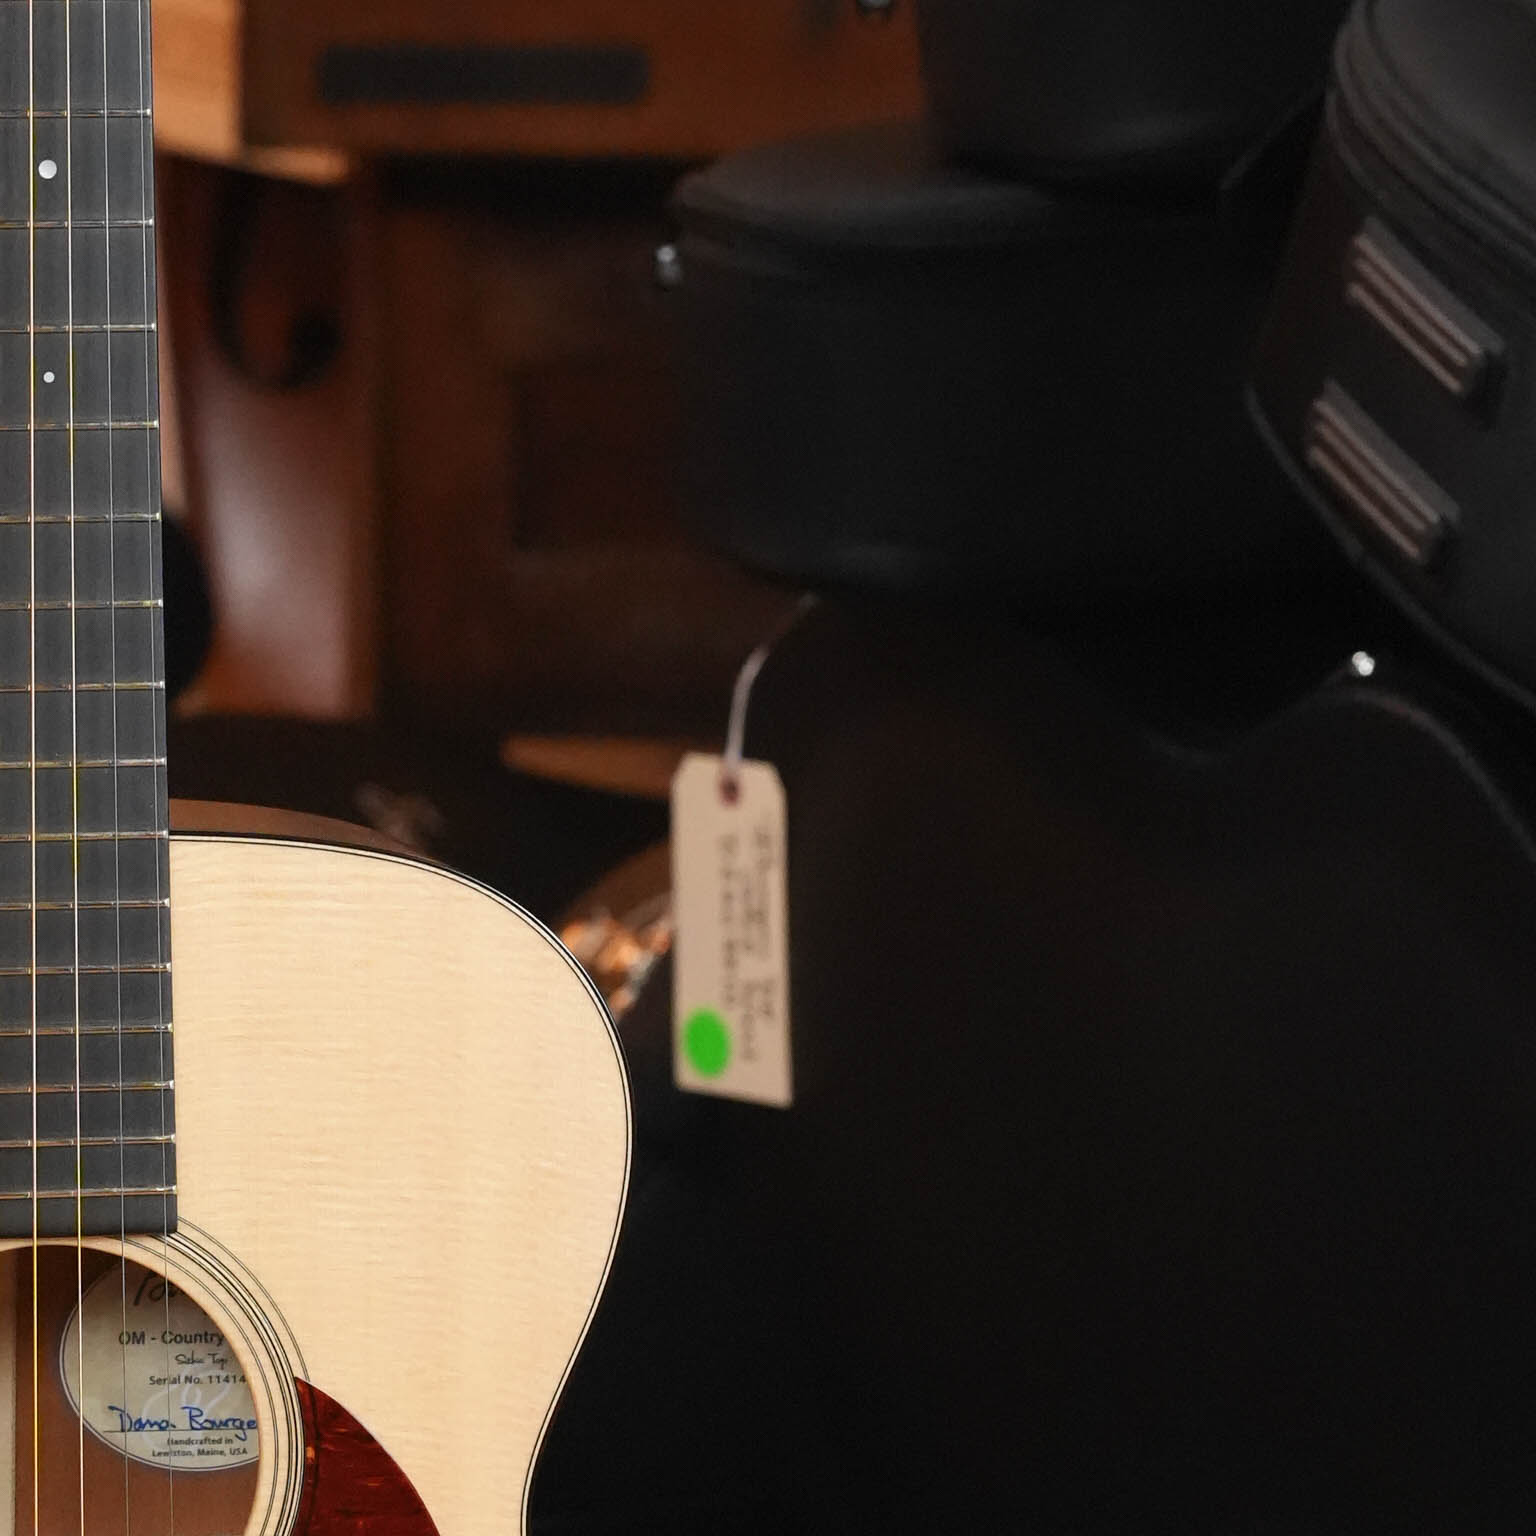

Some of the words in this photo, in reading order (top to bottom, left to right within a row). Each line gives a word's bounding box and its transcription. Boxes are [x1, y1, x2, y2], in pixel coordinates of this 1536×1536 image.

[119, 1330, 146, 1345] OM
[161, 1330, 225, 1347] Country
[149, 1375, 181, 1385] Seral
[152, 1449, 195, 1457] Lewston,
[230, 1448, 248, 1456] USA
